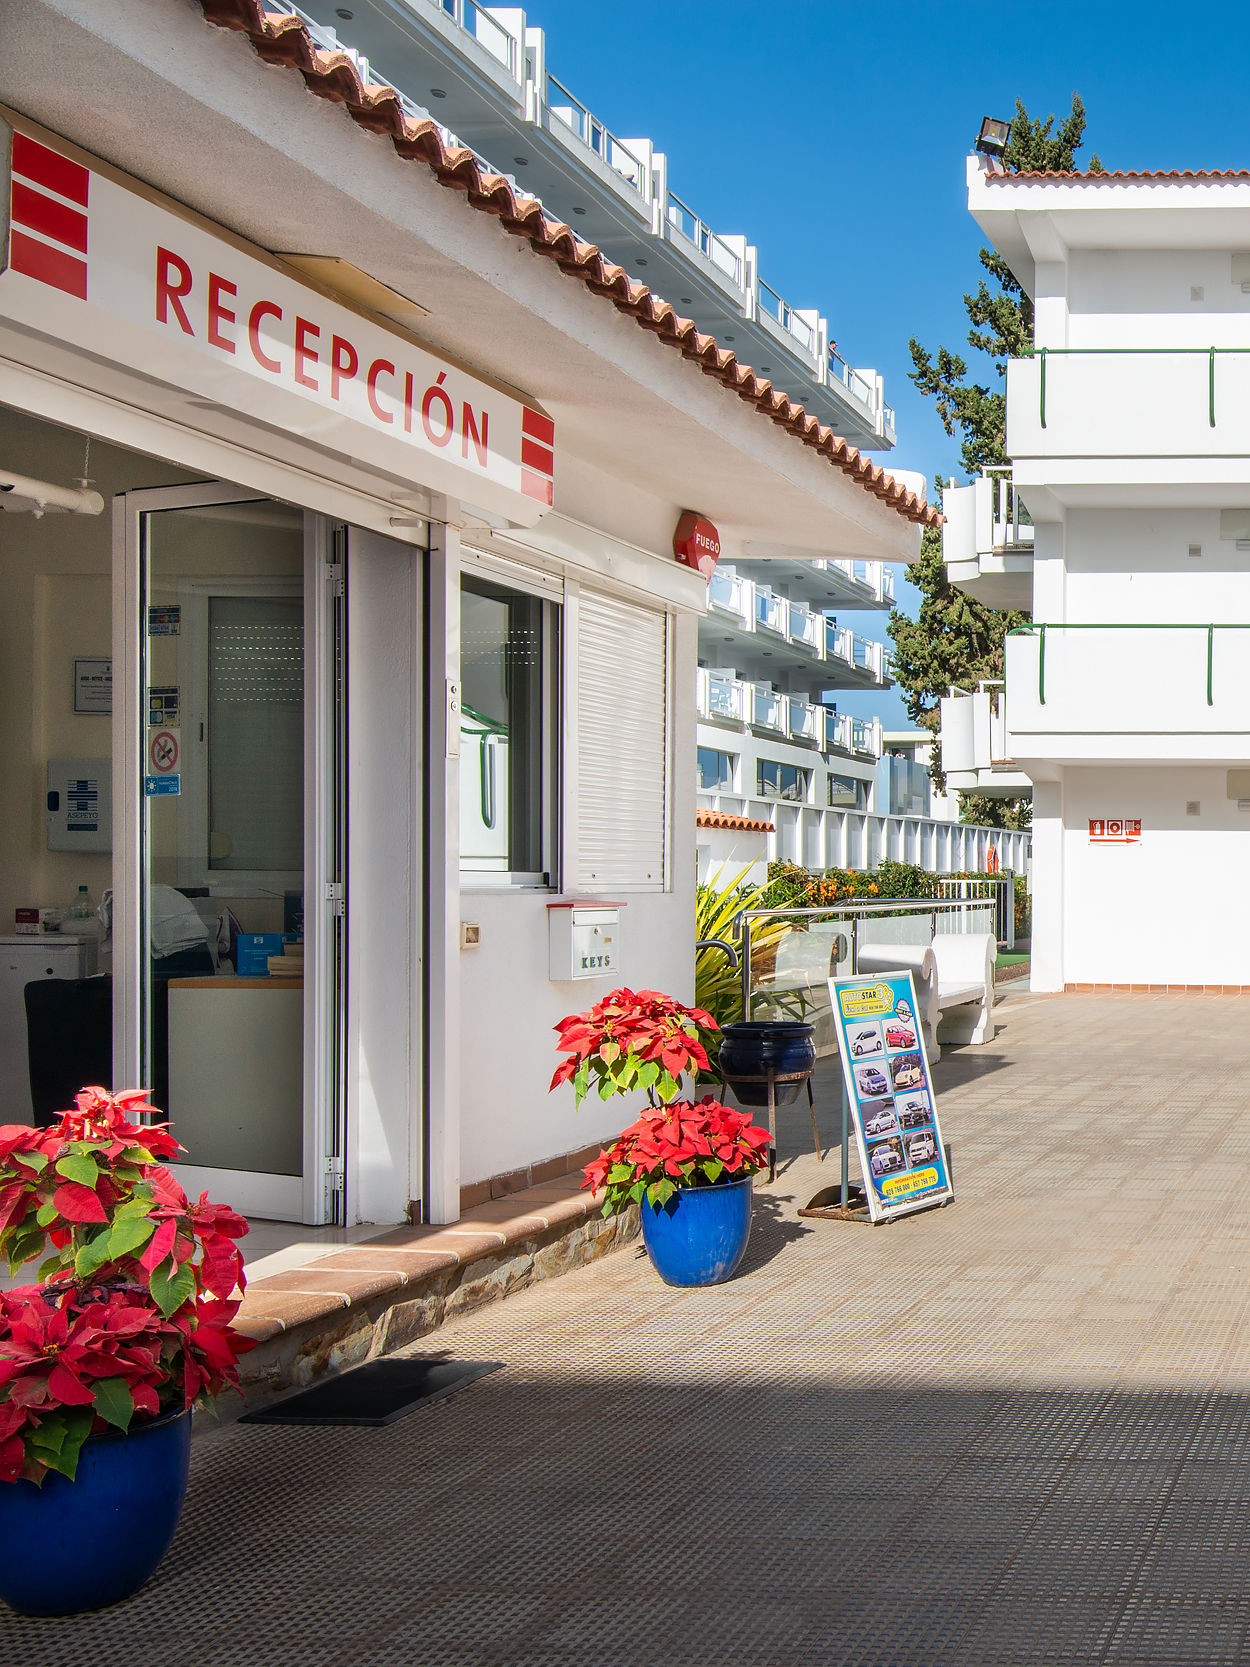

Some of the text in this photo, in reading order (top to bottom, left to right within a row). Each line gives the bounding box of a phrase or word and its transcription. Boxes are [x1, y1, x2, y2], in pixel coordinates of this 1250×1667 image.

[155, 245, 489, 468] RECEPCIÓN
[695, 533, 720, 554] FUEGO
[581, 955, 610, 969] KEYS
